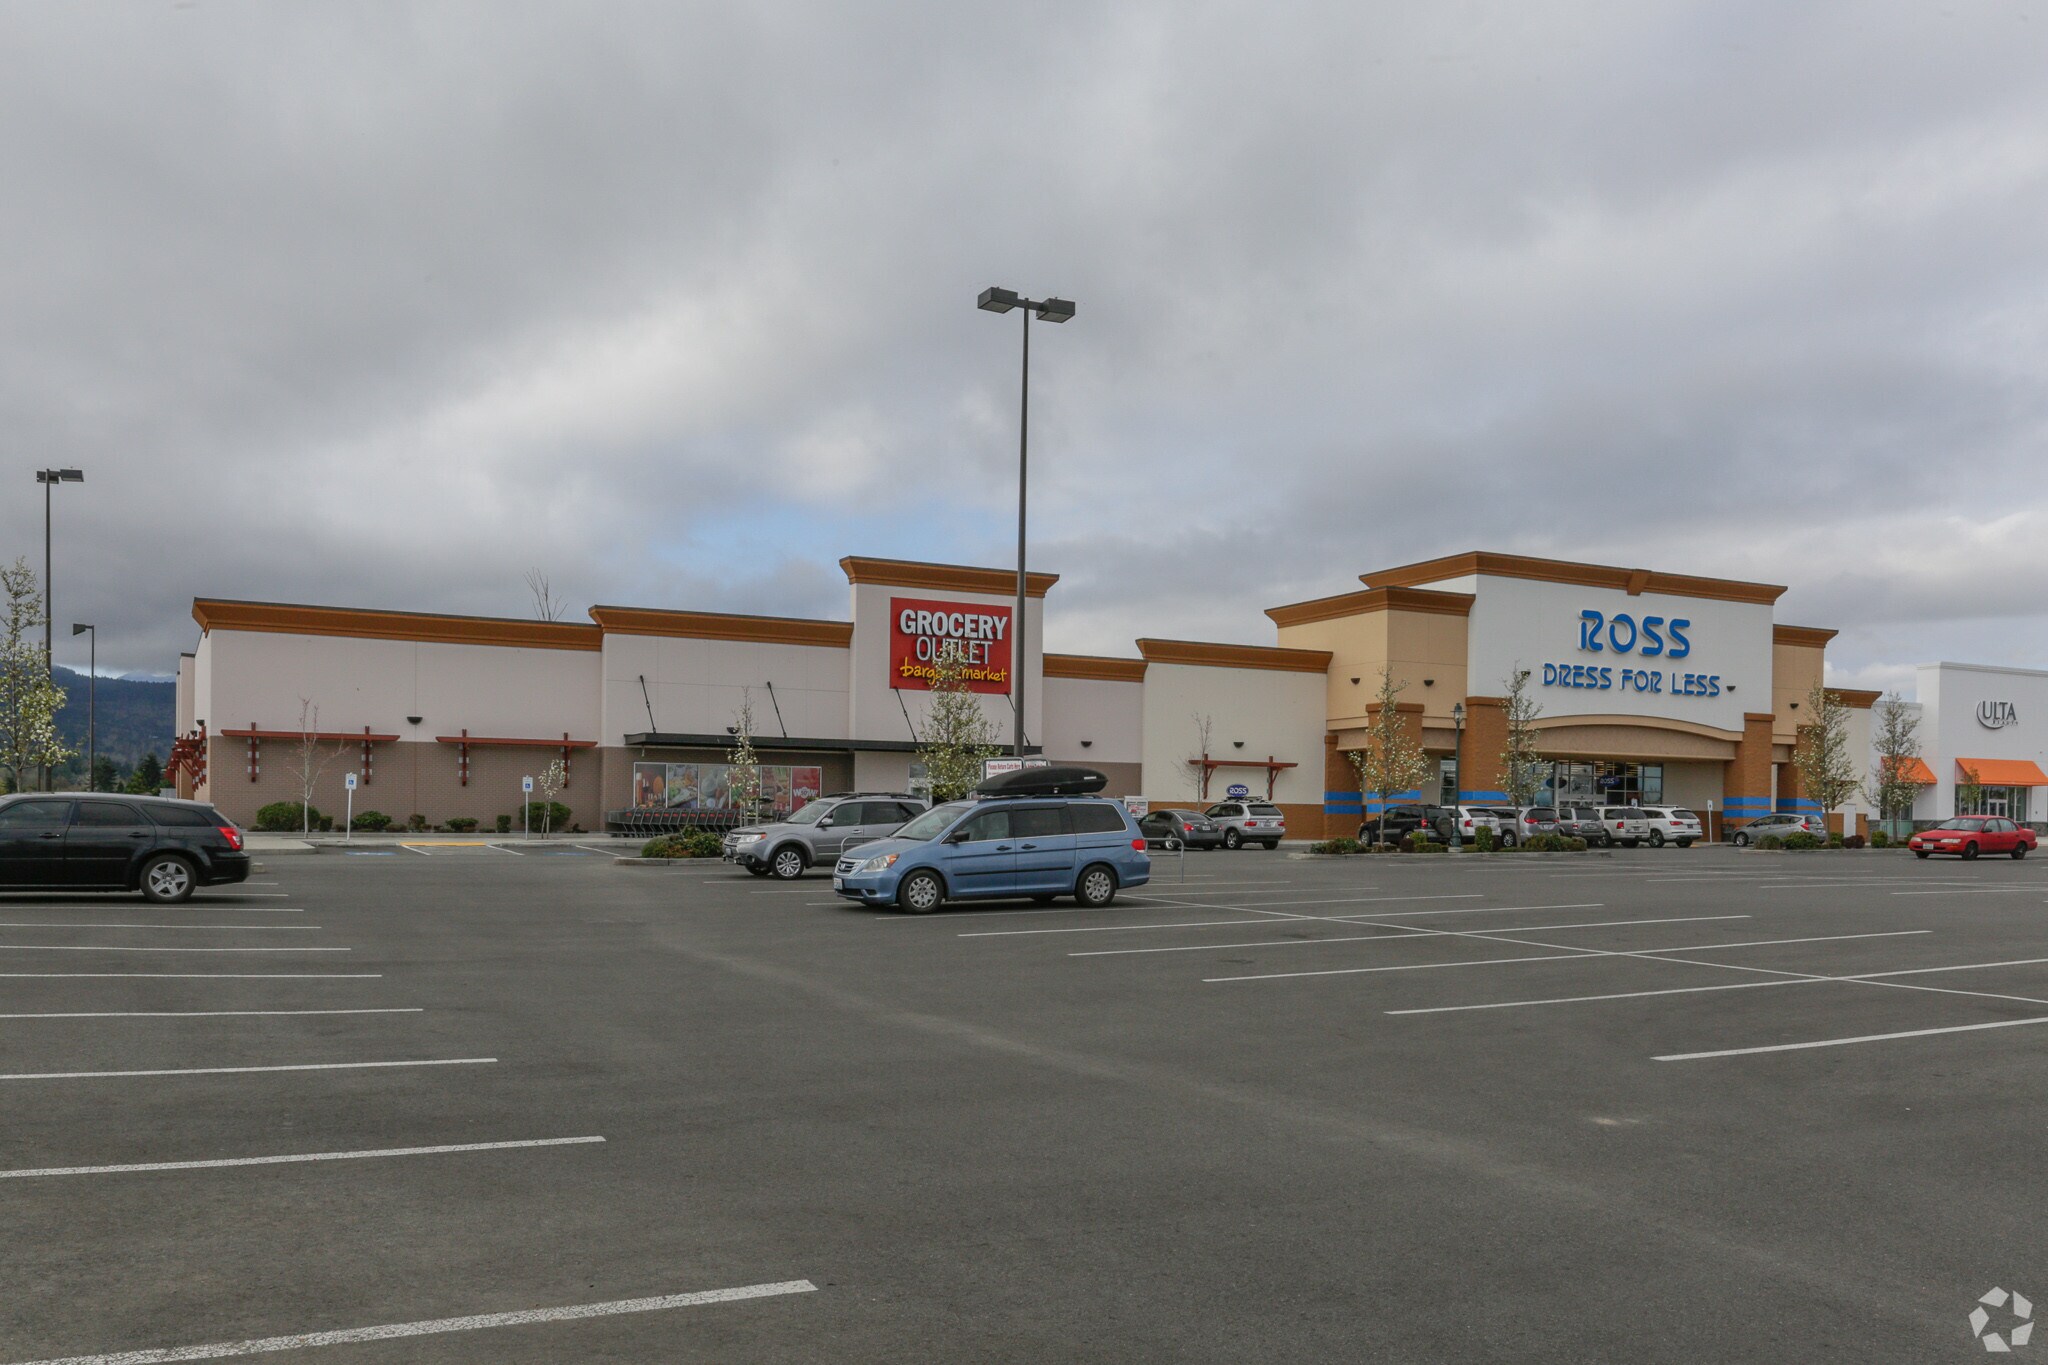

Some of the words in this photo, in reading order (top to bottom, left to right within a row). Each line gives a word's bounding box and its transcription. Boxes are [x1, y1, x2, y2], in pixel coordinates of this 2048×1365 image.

[900, 609, 1008, 640] GROCERY
[1578, 610, 1691, 658] ROSS
[916, 636, 993, 664] OUTLET
[961, 666, 1007, 682] market
[1543, 663, 1612, 690] DRESS
[1619, 669, 1662, 694] FOR
[1669, 672, 1720, 697] LESS
[1982, 700, 2017, 721] ULTA
[1229, 787, 1247, 795] ROSS
